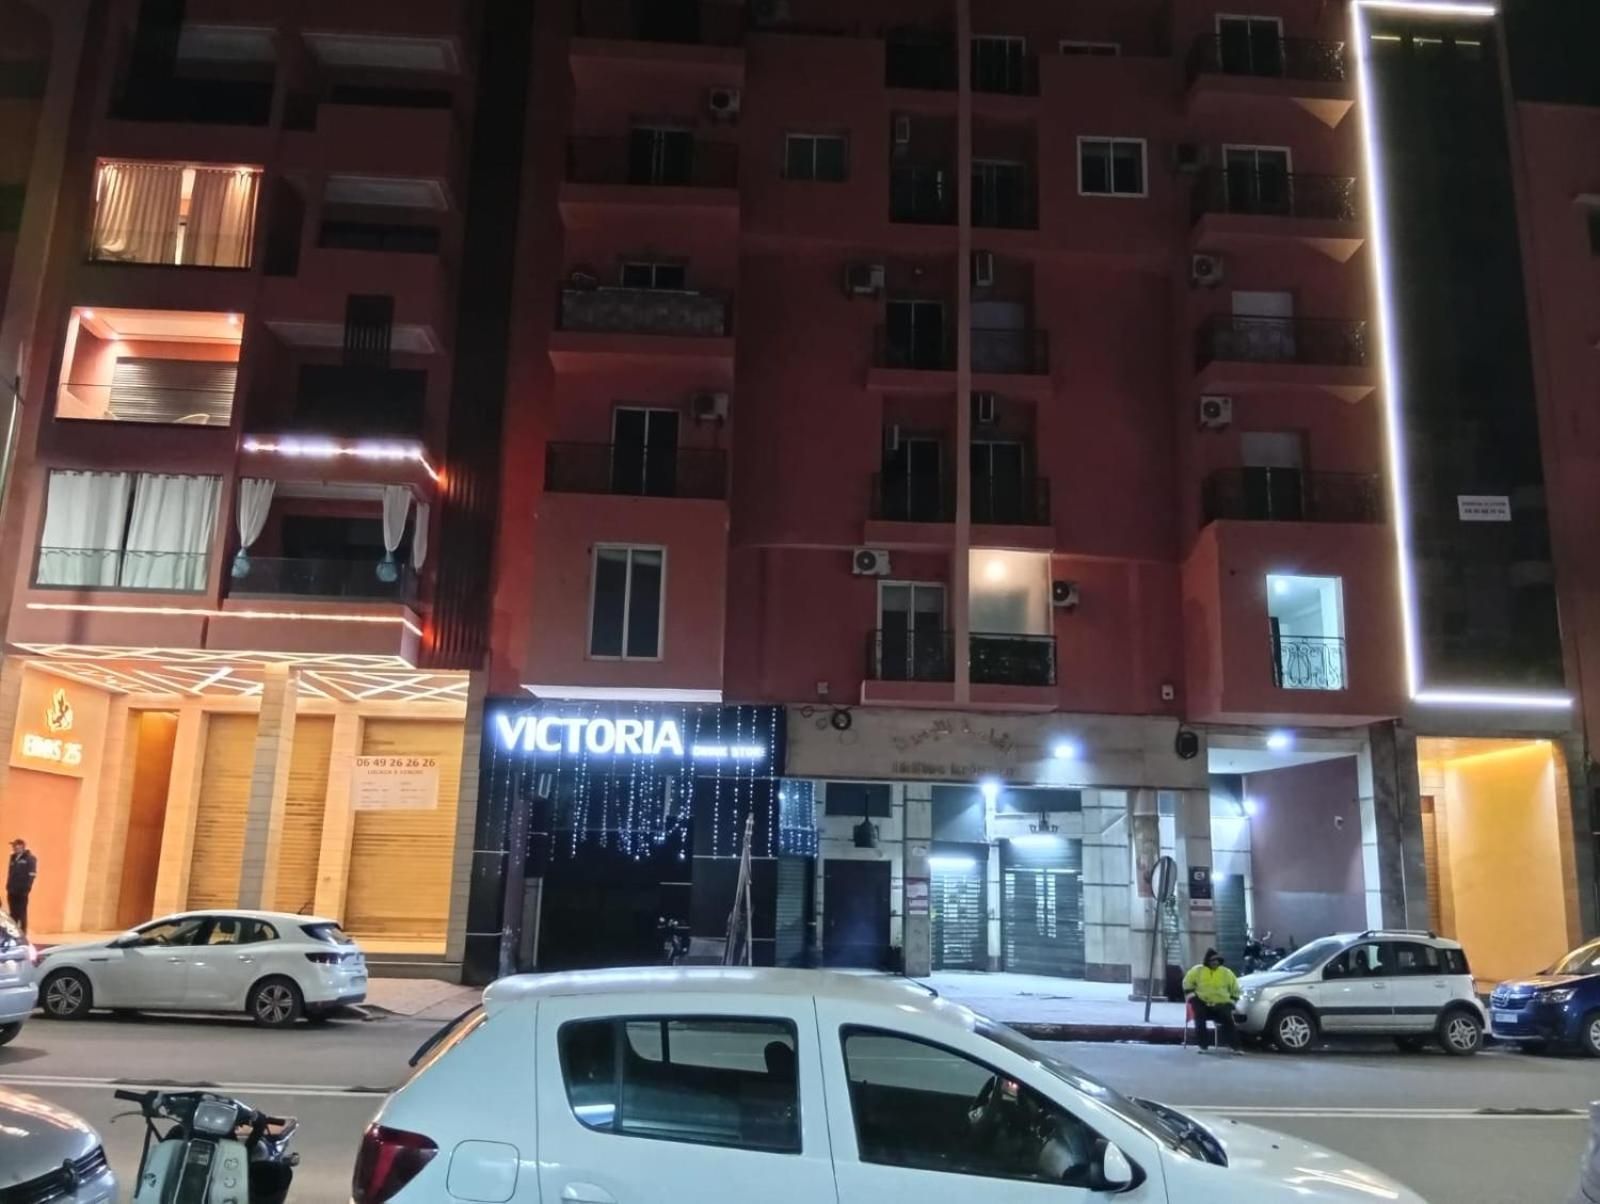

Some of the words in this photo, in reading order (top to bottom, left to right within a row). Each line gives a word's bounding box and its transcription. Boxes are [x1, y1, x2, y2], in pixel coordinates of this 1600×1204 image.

[495, 714, 685, 756] VICTORIA
[356, 758, 370, 767] 06
[372, 758, 386, 767] 49
[389, 758, 403, 767] 26
[405, 758, 420, 767] 26
[422, 758, 436, 767] 26
